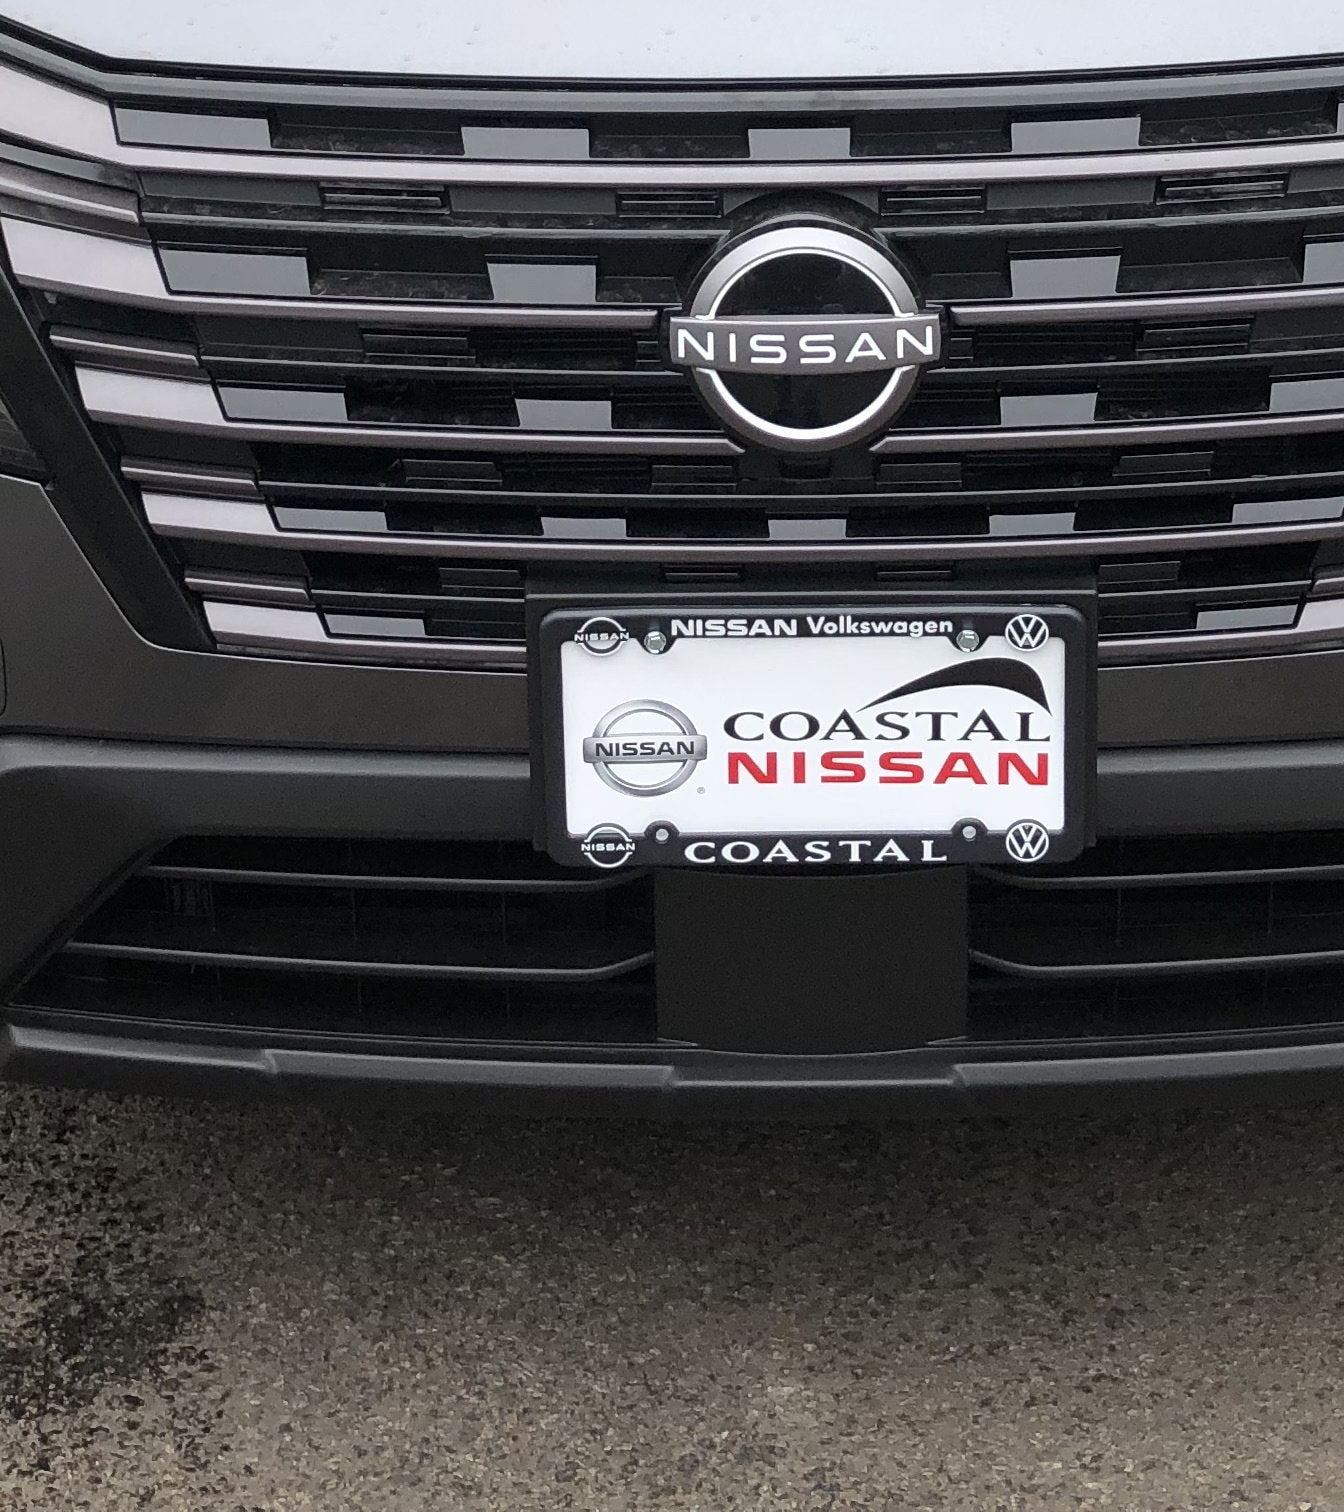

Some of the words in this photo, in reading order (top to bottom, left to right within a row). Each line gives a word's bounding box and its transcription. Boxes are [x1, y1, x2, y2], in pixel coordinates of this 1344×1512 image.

[677, 325, 934, 364] NISSAN
[573, 631, 630, 643] NISSAN
[671, 618, 798, 637] NISSAN
[806, 614, 953, 637] Volkswagen
[723, 708, 1052, 743] COASTAL
[594, 741, 696, 758] NISSAN
[727, 750, 1050, 786] NISSAN
[580, 842, 636, 852] NISSAN
[684, 838, 948, 863] COASTAL
